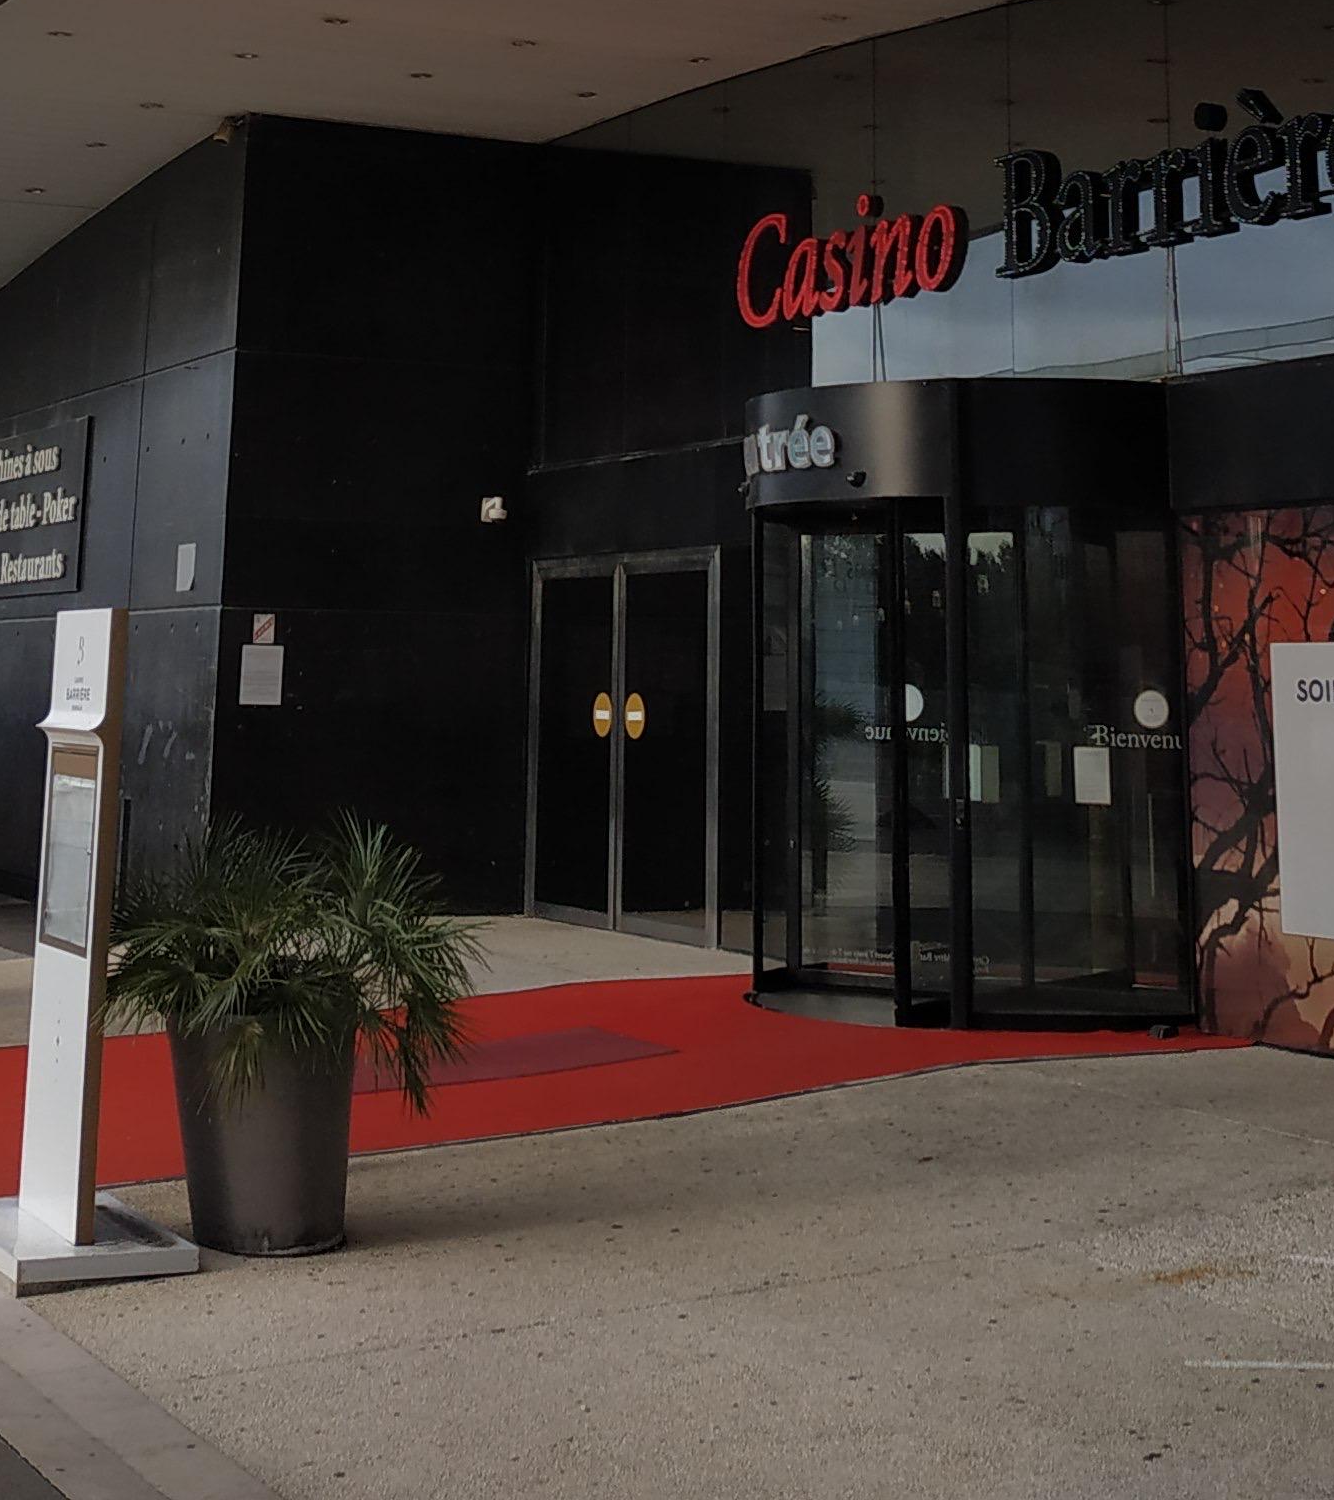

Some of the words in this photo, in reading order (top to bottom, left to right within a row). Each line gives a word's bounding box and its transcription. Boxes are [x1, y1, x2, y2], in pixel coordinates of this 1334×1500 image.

[736, 193, 960, 329] Casino
[25, 444, 33, 476] à
[34, 446, 60, 475] sous
[744, 414, 836, 476] trée
[10, 492, 36, 531] table
[41, 486, 77, 526] Poker
[0, 548, 65, 585] Restaurants
